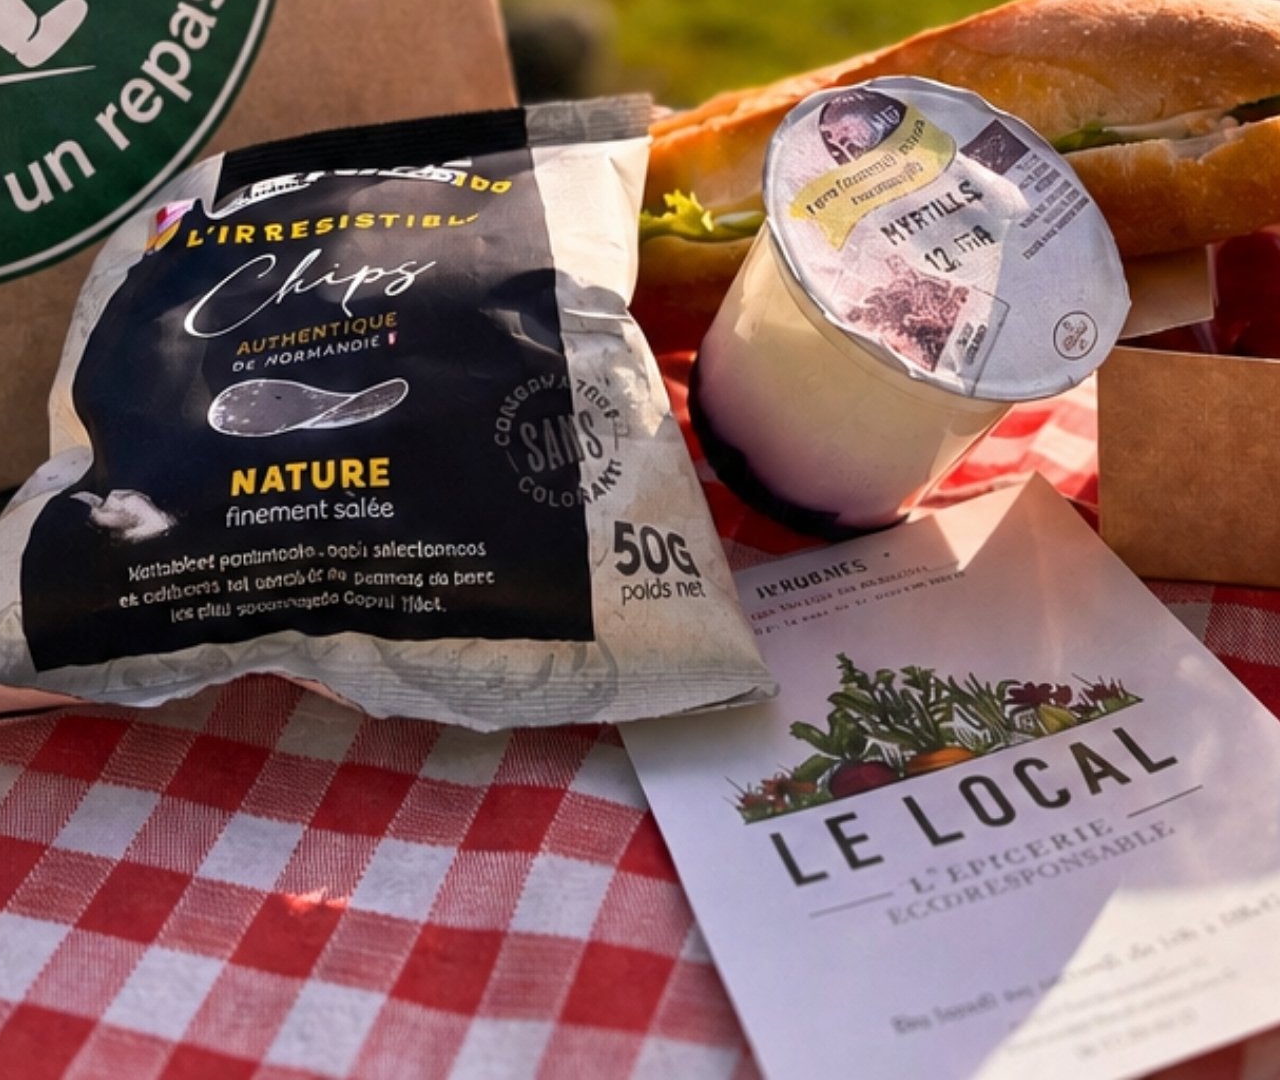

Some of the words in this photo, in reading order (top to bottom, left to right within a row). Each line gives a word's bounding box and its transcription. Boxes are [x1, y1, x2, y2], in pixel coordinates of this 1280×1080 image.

[183, 247, 438, 338] Chips
[231, 359, 256, 373] DE
[264, 334, 381, 368] NORMANDIE
[236, 311, 399, 356] AUTHENTIQUE
[520, 410, 603, 472] SANS
[230, 456, 392, 497] NATURE
[226, 498, 328, 528] finement
[333, 496, 395, 521] salée
[613, 520, 702, 578] 50G
[621, 577, 672, 606] poids
[675, 580, 707, 599] net
[770, 812, 884, 887] LE
[902, 726, 1179, 847] LOCAL
